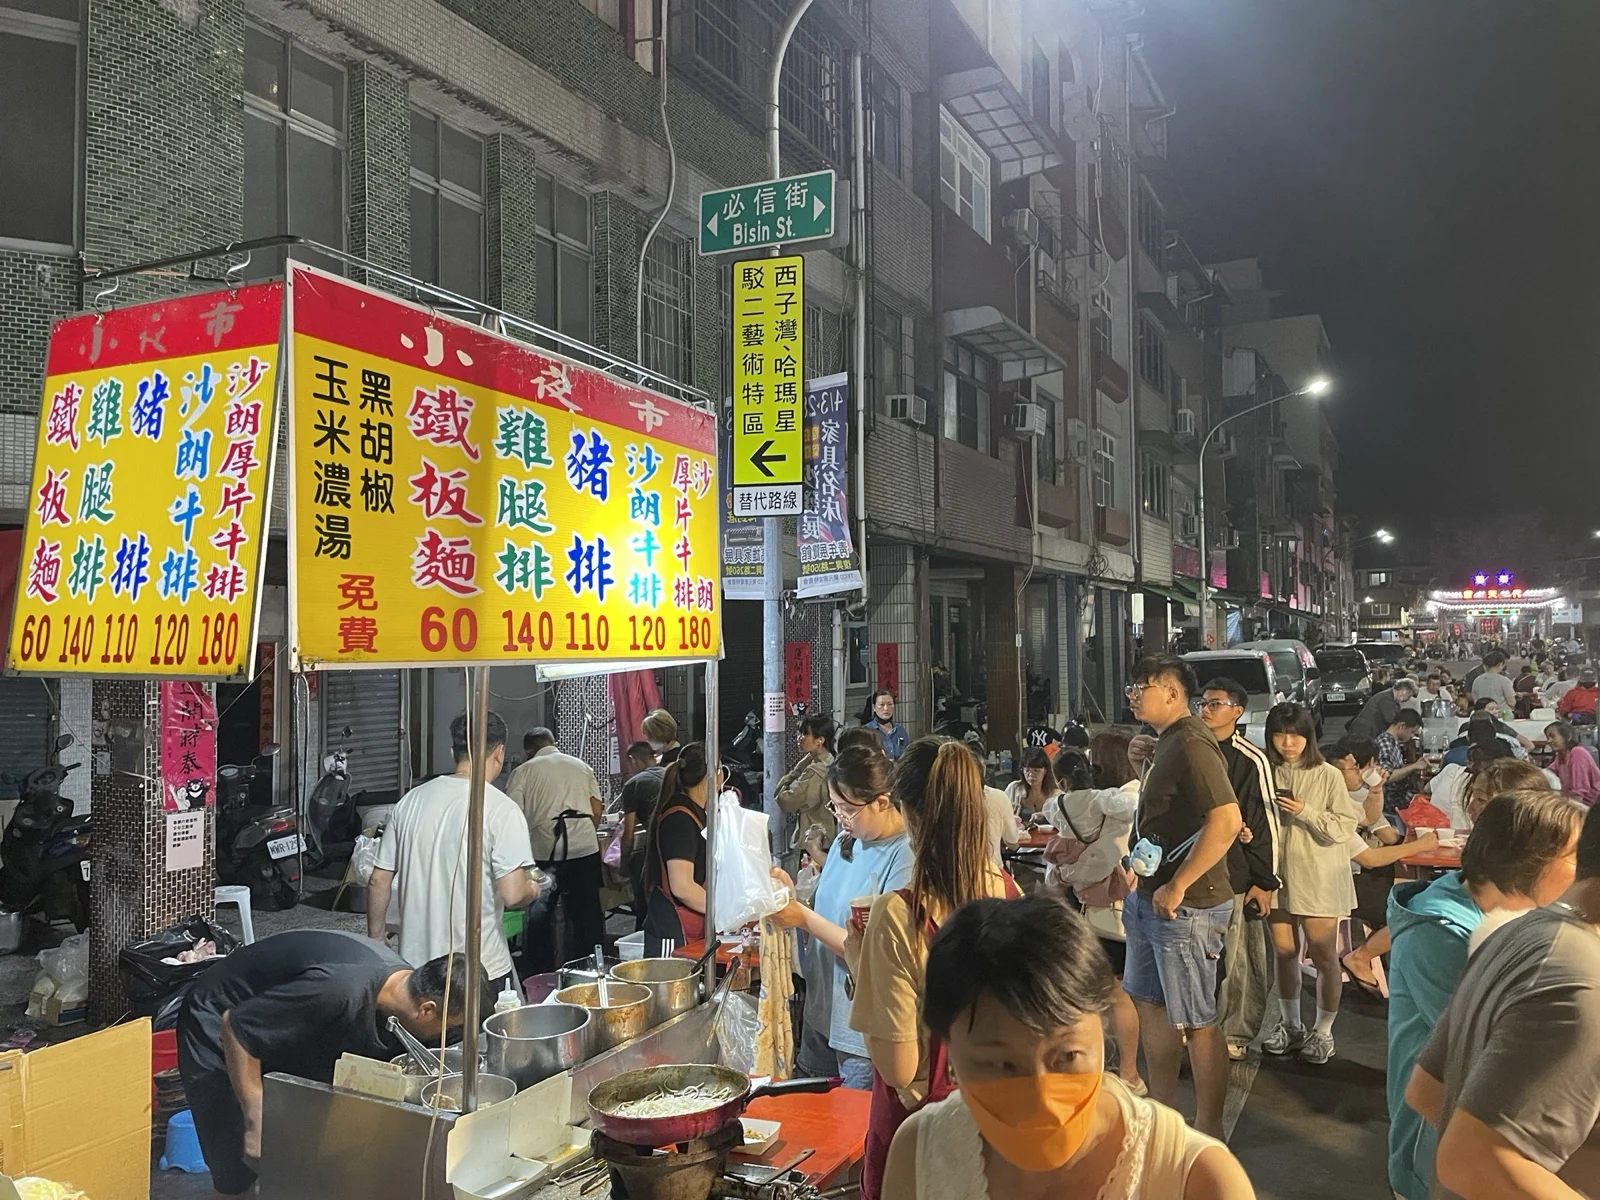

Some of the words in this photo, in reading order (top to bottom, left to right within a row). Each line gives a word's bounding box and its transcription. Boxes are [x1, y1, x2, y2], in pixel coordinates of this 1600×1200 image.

[722, 182, 809, 220] 必信街
[733, 220, 770, 245] Bisin
[776, 215, 796, 238] St.
[741, 267, 765, 436] 駁二藝術特區
[773, 264, 798, 433] 西子灣、哈瑪星
[68, 379, 122, 602] 雞腿排
[110, 372, 169, 602] 豬排
[159, 363, 218, 603] 沙朗牛排
[202, 357, 269, 602] 沙朗厚片牛排
[313, 355, 351, 560] 玉米濃湯
[359, 369, 395, 514] 黑胡椒
[408, 387, 482, 595] 鐵板麵
[497, 408, 555, 598] 雞腿排
[566, 432, 615, 601] 豬排
[739, 491, 798, 511] 替代路線
[627, 445, 662, 608] 沙朗牛排
[21, 614, 50, 662] 60
[59, 614, 94, 665] 140
[101, 613, 138, 664] 110
[150, 613, 189, 665] 120
[198, 612, 239, 665] 180
[338, 573, 378, 653] 免費
[420, 607, 478, 652] 60
[502, 610, 553, 651] 140
[566, 611, 609, 651] 110
[628, 615, 666, 651] 120
[678, 616, 711, 650] 180
[1031, 729, 1048, 747] NY
